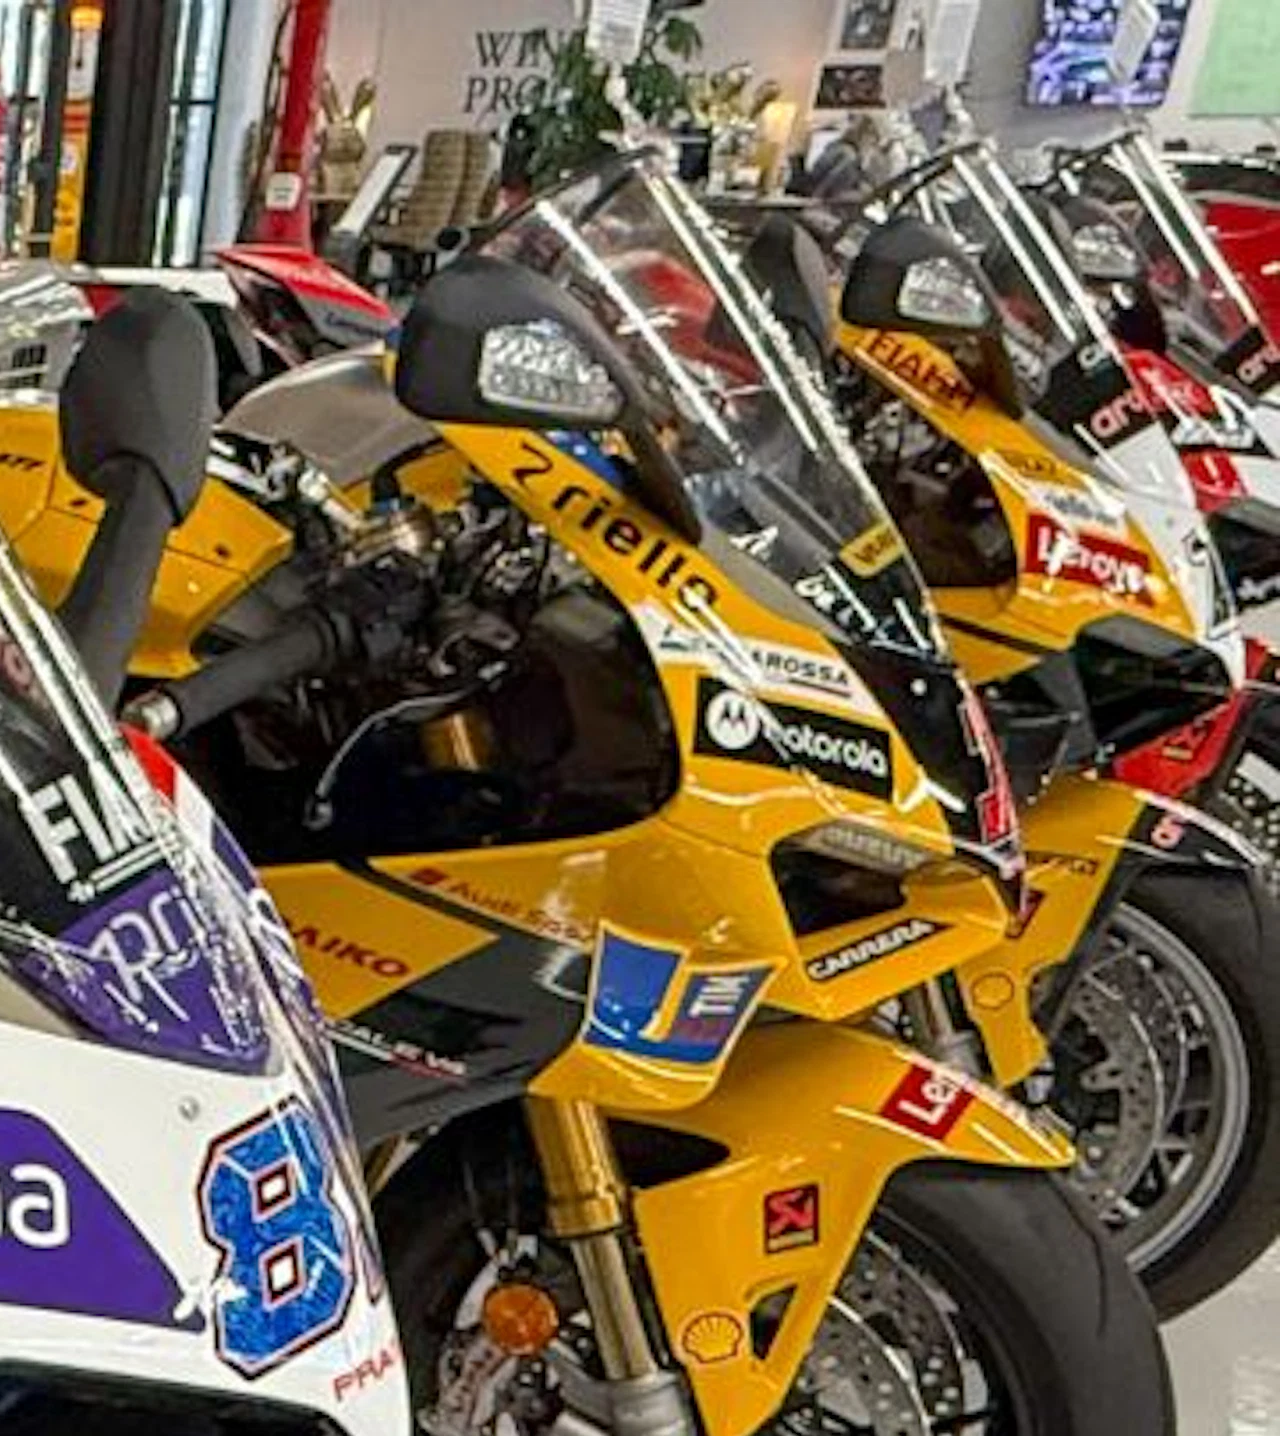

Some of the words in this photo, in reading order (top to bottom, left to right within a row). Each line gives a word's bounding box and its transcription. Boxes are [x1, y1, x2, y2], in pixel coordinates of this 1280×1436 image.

[553, 483, 720, 614] riello
[761, 712, 889, 780] motorola
[806, 918, 937, 980] CARRERA
[196, 1094, 382, 1384] 8
